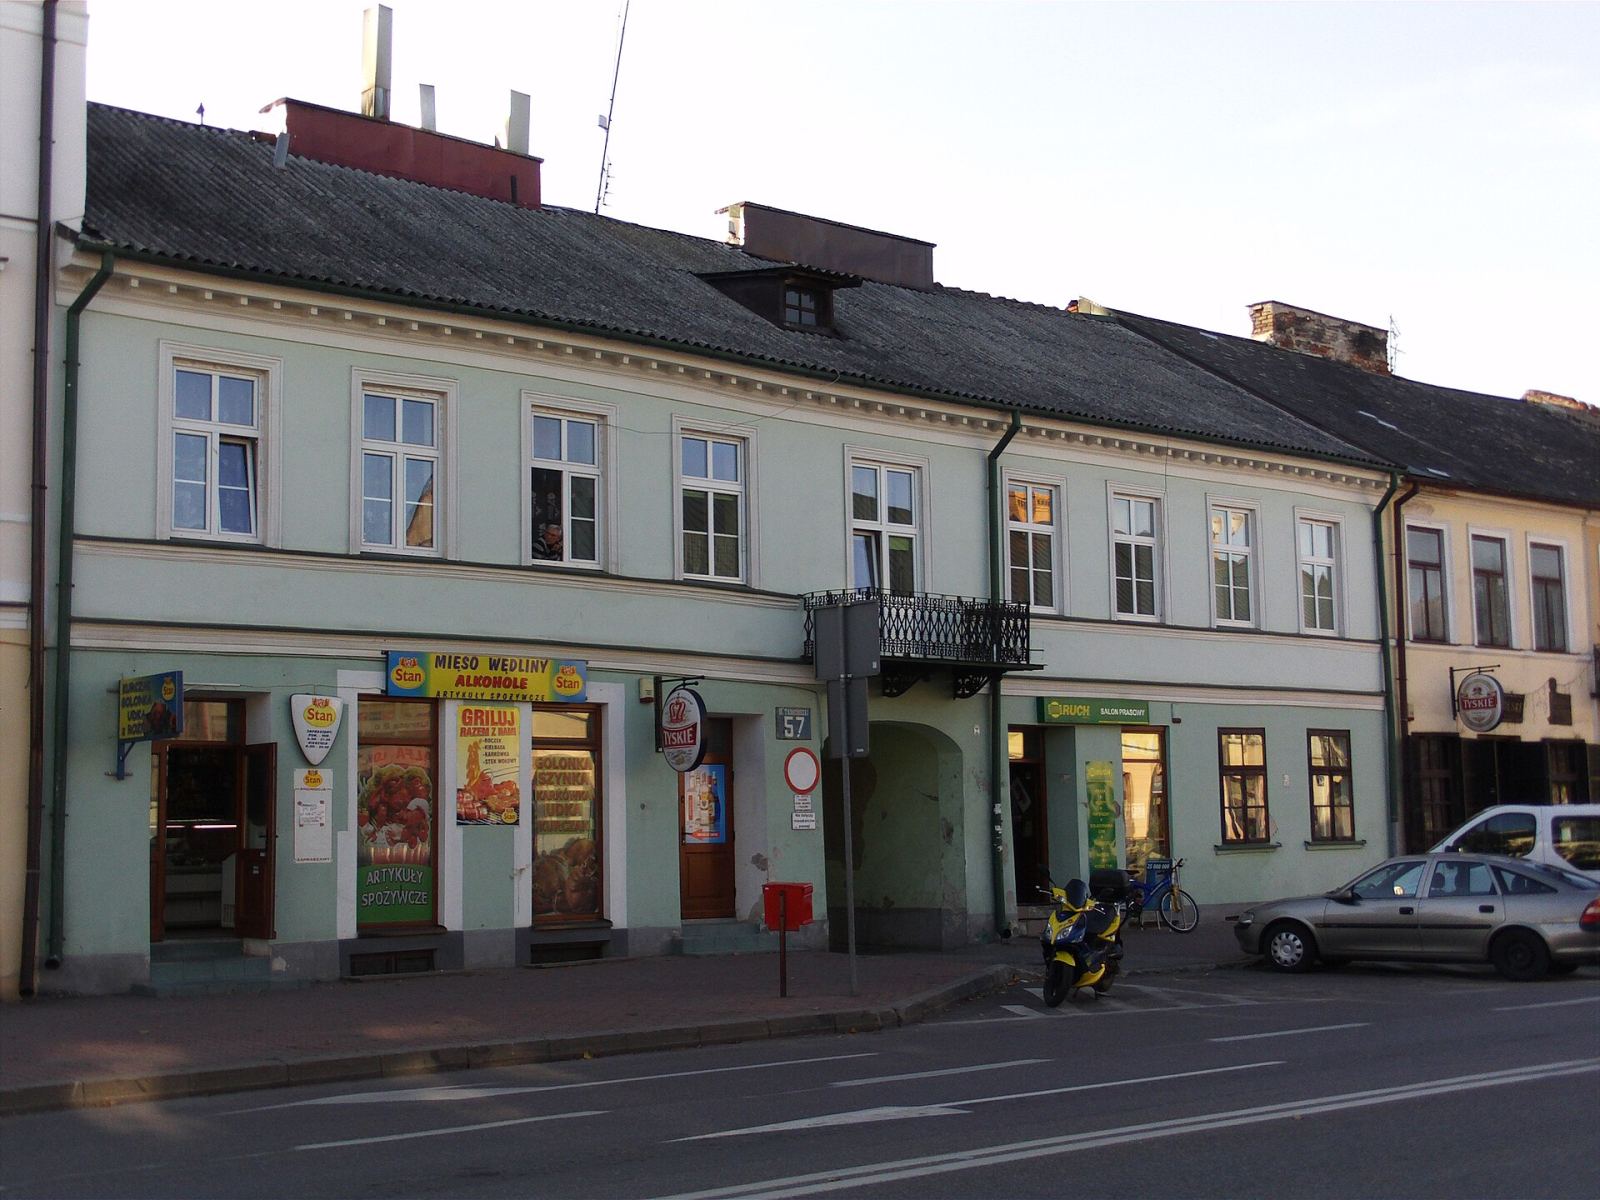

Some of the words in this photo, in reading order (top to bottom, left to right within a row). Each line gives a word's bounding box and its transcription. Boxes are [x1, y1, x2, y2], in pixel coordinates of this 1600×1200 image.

[435, 655, 479, 671] MIĘSO
[489, 658, 548, 674] WĘDLINY
[395, 668, 421, 682] Stan
[455, 675, 528, 689] ALKOHOLE
[556, 676, 580, 689] Stan
[1463, 697, 1495, 708] TYSKIE
[307, 708, 333, 721] Stan
[461, 708, 515, 726] GRILUJ
[1063, 705, 1090, 716] RUCH
[460, 727, 490, 737] RAZEM
[491, 727, 497, 736] Z
[784, 716, 805, 738] 57
[663, 728, 695, 746] TYSKIE
[305, 776, 321, 784] Stan
[366, 867, 423, 886] ARTYKUŁY
